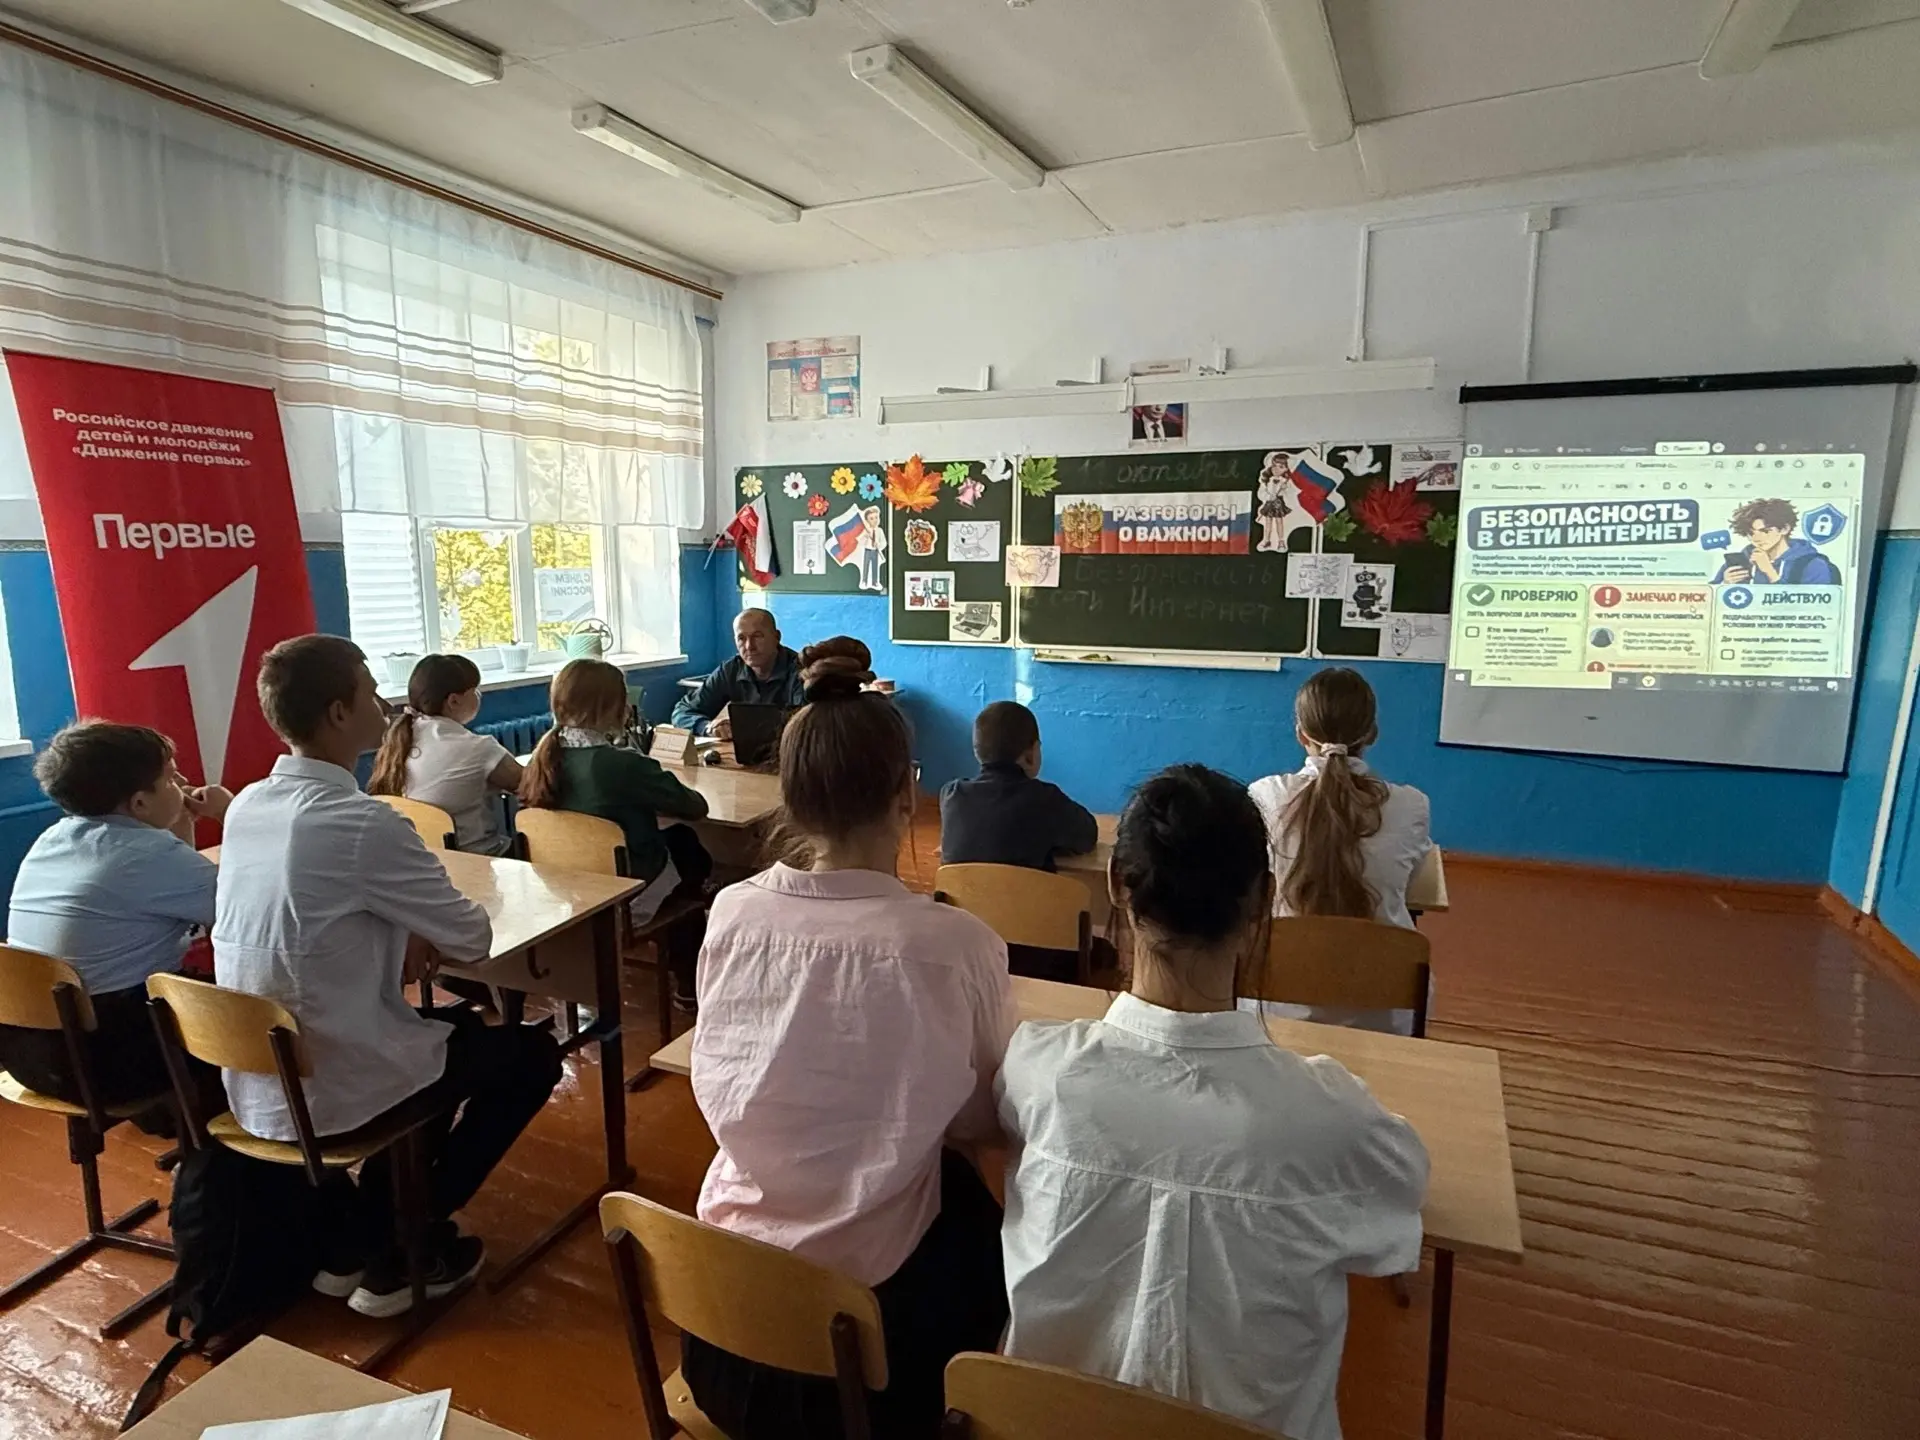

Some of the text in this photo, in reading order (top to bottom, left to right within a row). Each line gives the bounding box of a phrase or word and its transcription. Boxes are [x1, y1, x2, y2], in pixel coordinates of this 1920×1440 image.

[53, 408, 254, 441] Российское движение
[77, 428, 241, 452] детей и молодёжи
[72, 444, 251, 467] «Движение первых»
[1112, 504, 1238, 523] РАЗГОВОРЫ
[1480, 503, 1690, 529] БЕЗОПАСНОСТЬ
[93, 513, 256, 560] Первые
[1119, 526, 1229, 543] О ВАЖНОМ
[1477, 522, 1693, 547] В СЕТИ ИНТЕРНЕТ
[1501, 589, 1579, 602] ПРОВЕРЯЮ
[1626, 592, 1707, 603] ЗАМЕЧАЮ РИСК
[1762, 591, 1832, 606] ДЕЙСТВУЮ
